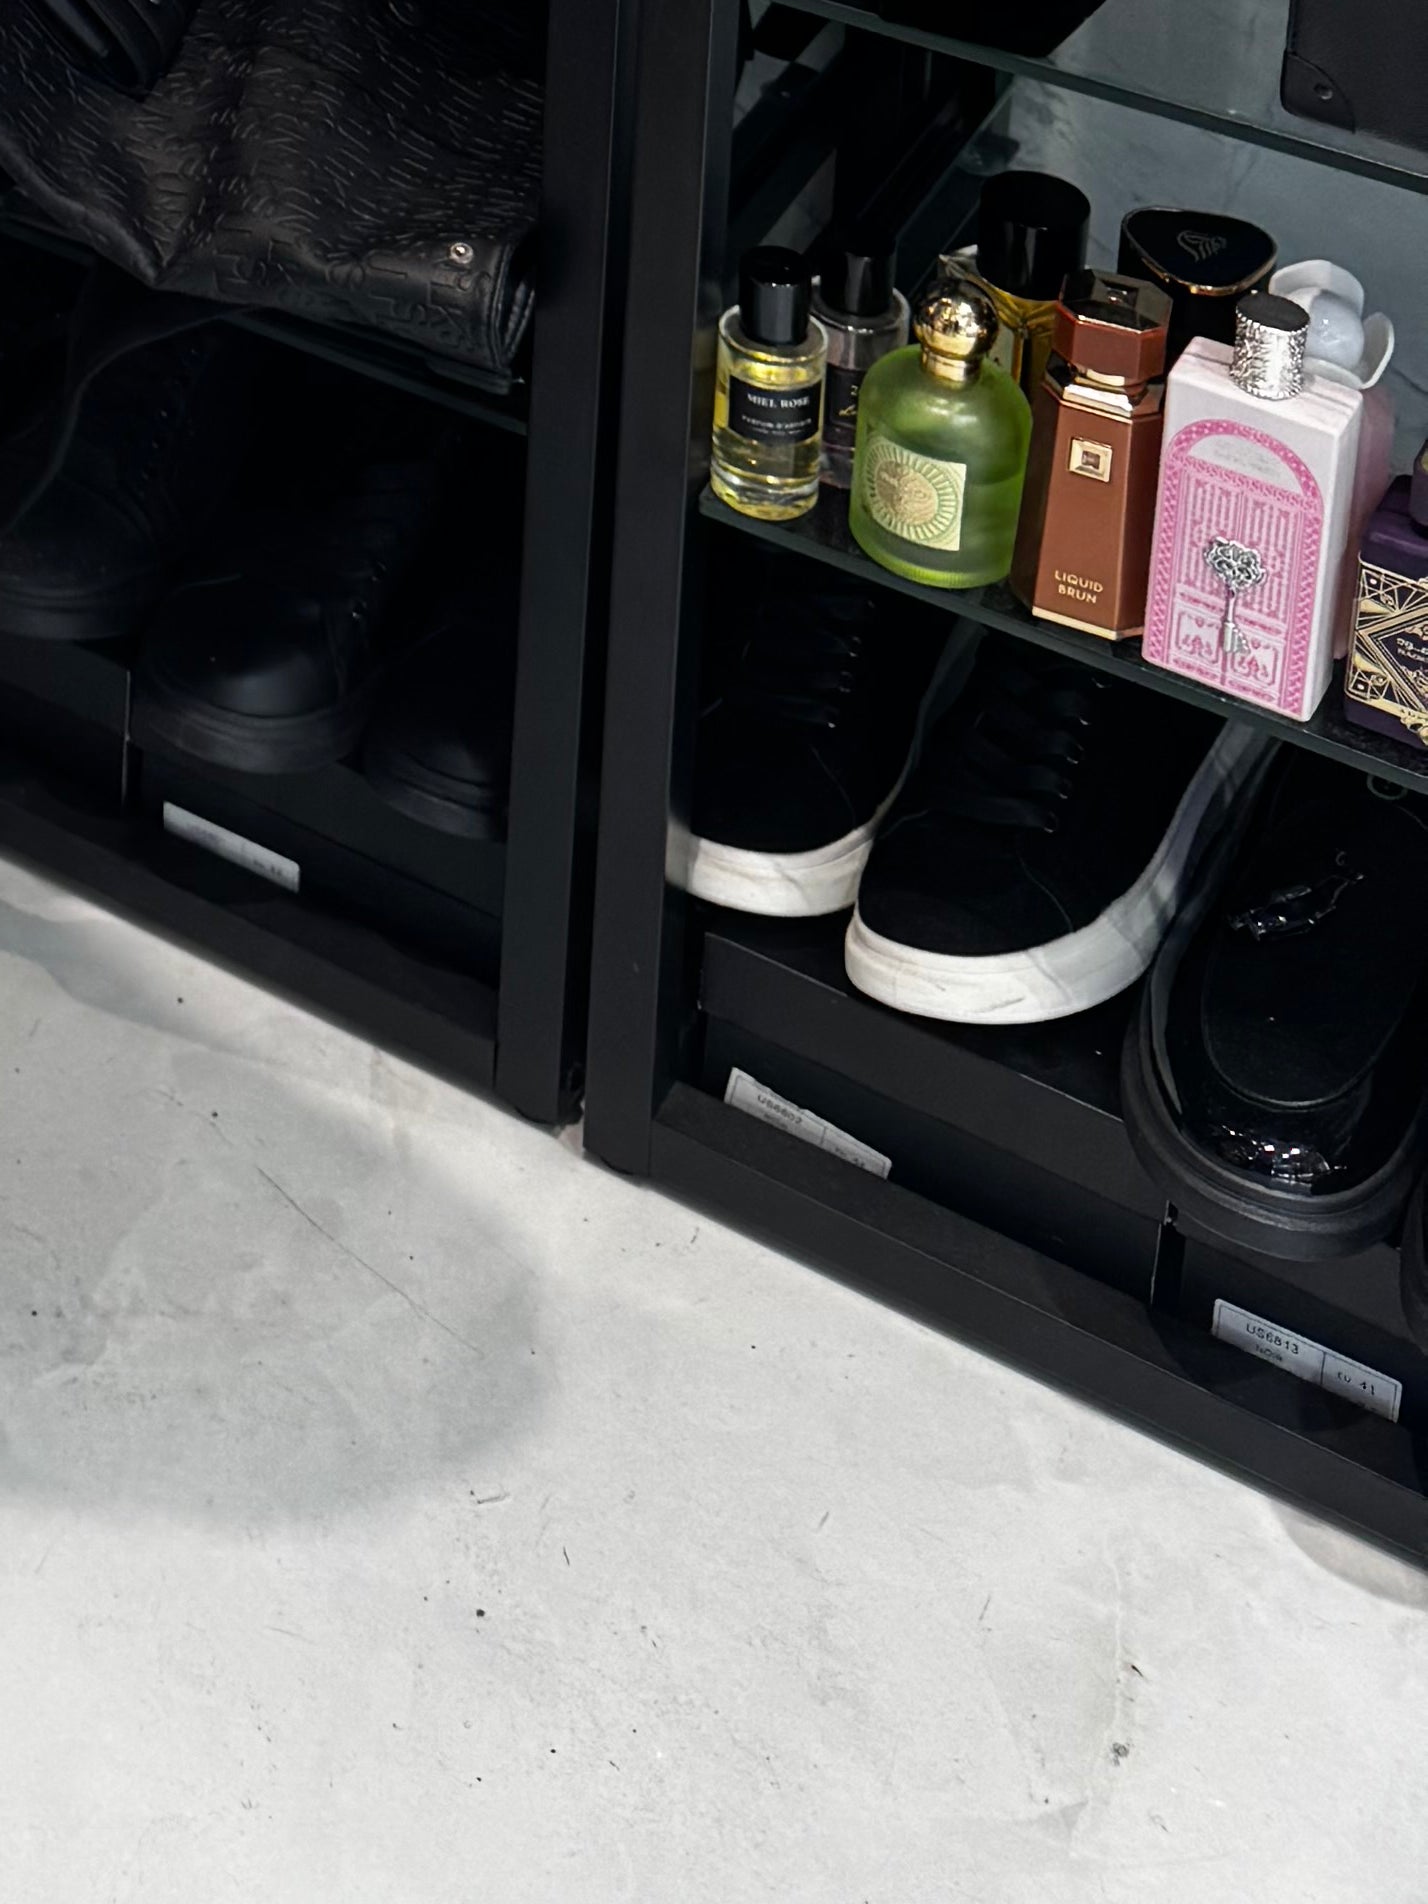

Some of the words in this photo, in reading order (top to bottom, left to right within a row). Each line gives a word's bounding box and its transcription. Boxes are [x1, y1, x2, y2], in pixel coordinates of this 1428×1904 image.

[746, 392, 777, 409] MIEL
[780, 395, 810, 409] ROSE
[1054, 570, 1104, 593] LIQUID
[1058, 583, 1097, 604] BRUN
